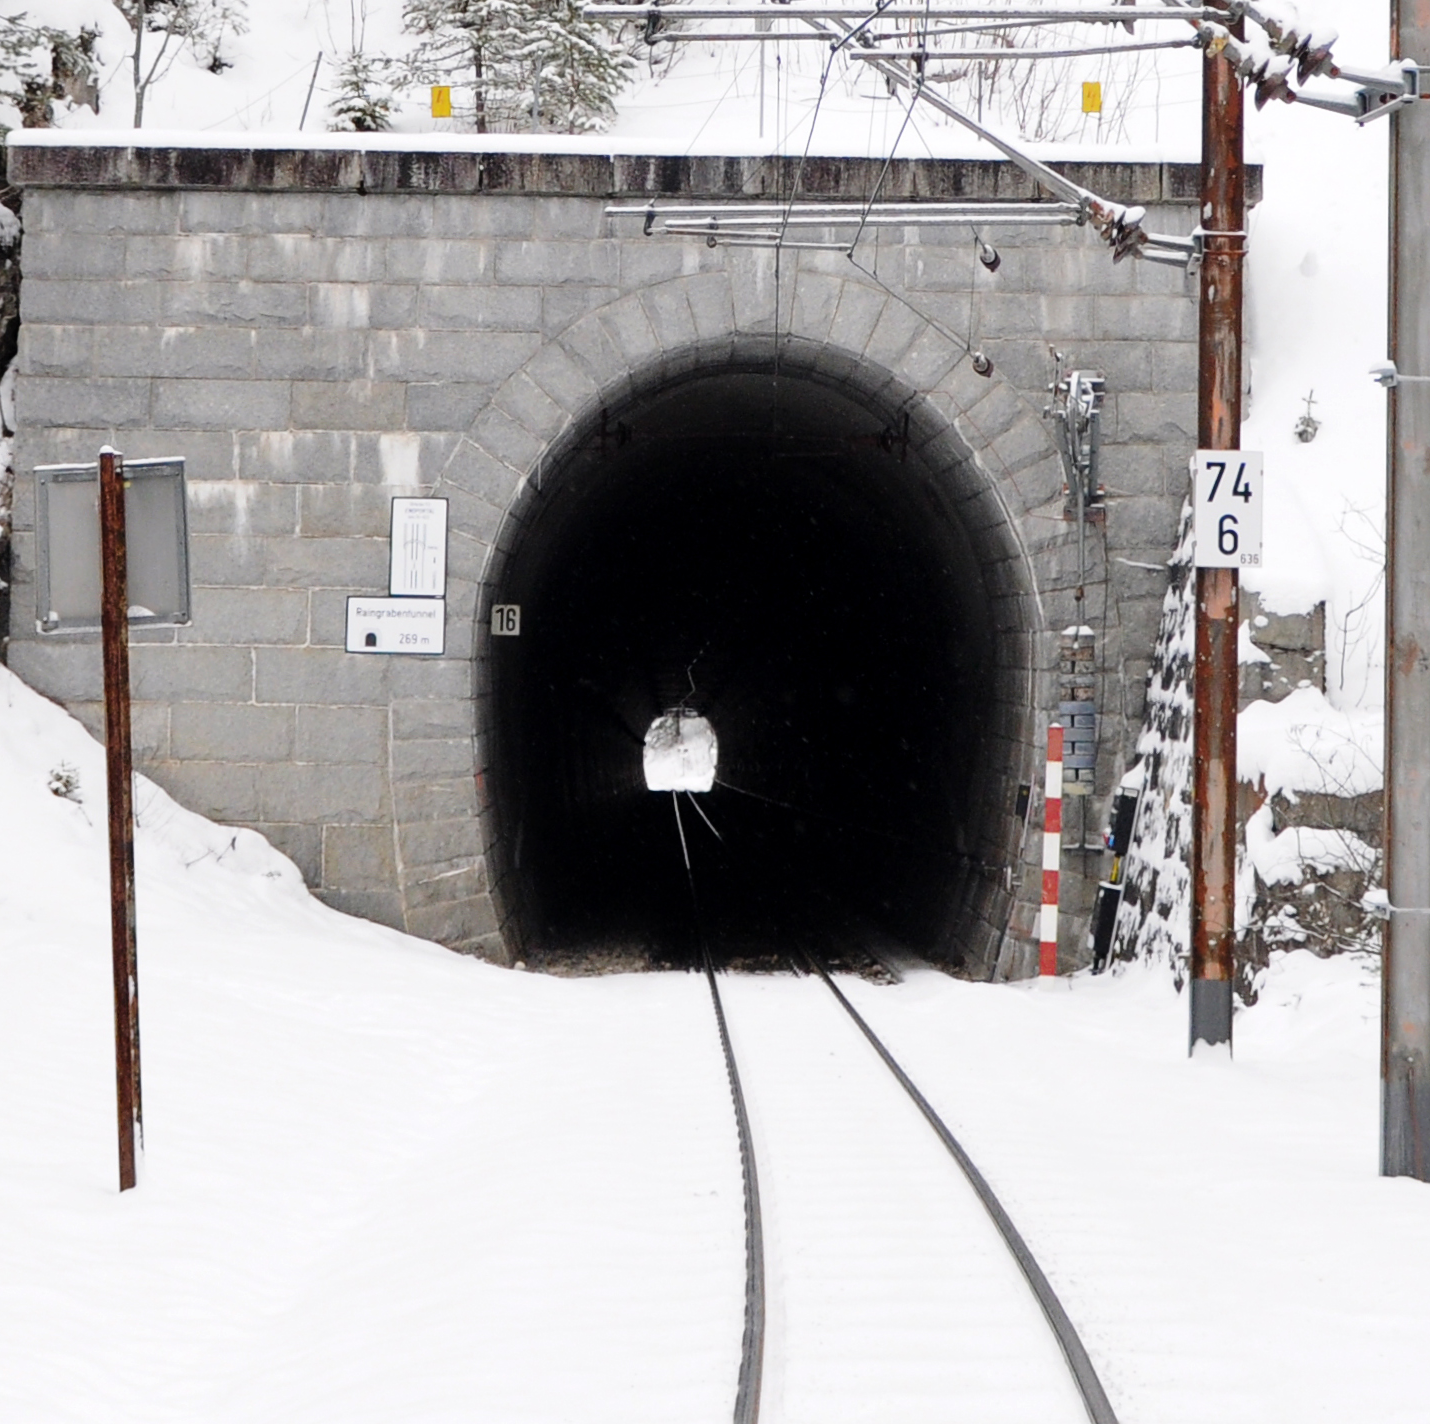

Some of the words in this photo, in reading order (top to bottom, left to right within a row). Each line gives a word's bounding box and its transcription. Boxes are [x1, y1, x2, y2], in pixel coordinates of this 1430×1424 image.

[1206, 462, 1252, 504] 74
[1217, 514, 1239, 556] 6
[1240, 553, 1259, 565] 636
[356, 607, 436, 619] Raingrabentunnel
[495, 607, 516, 632] 16
[399, 633, 418, 644] 269
